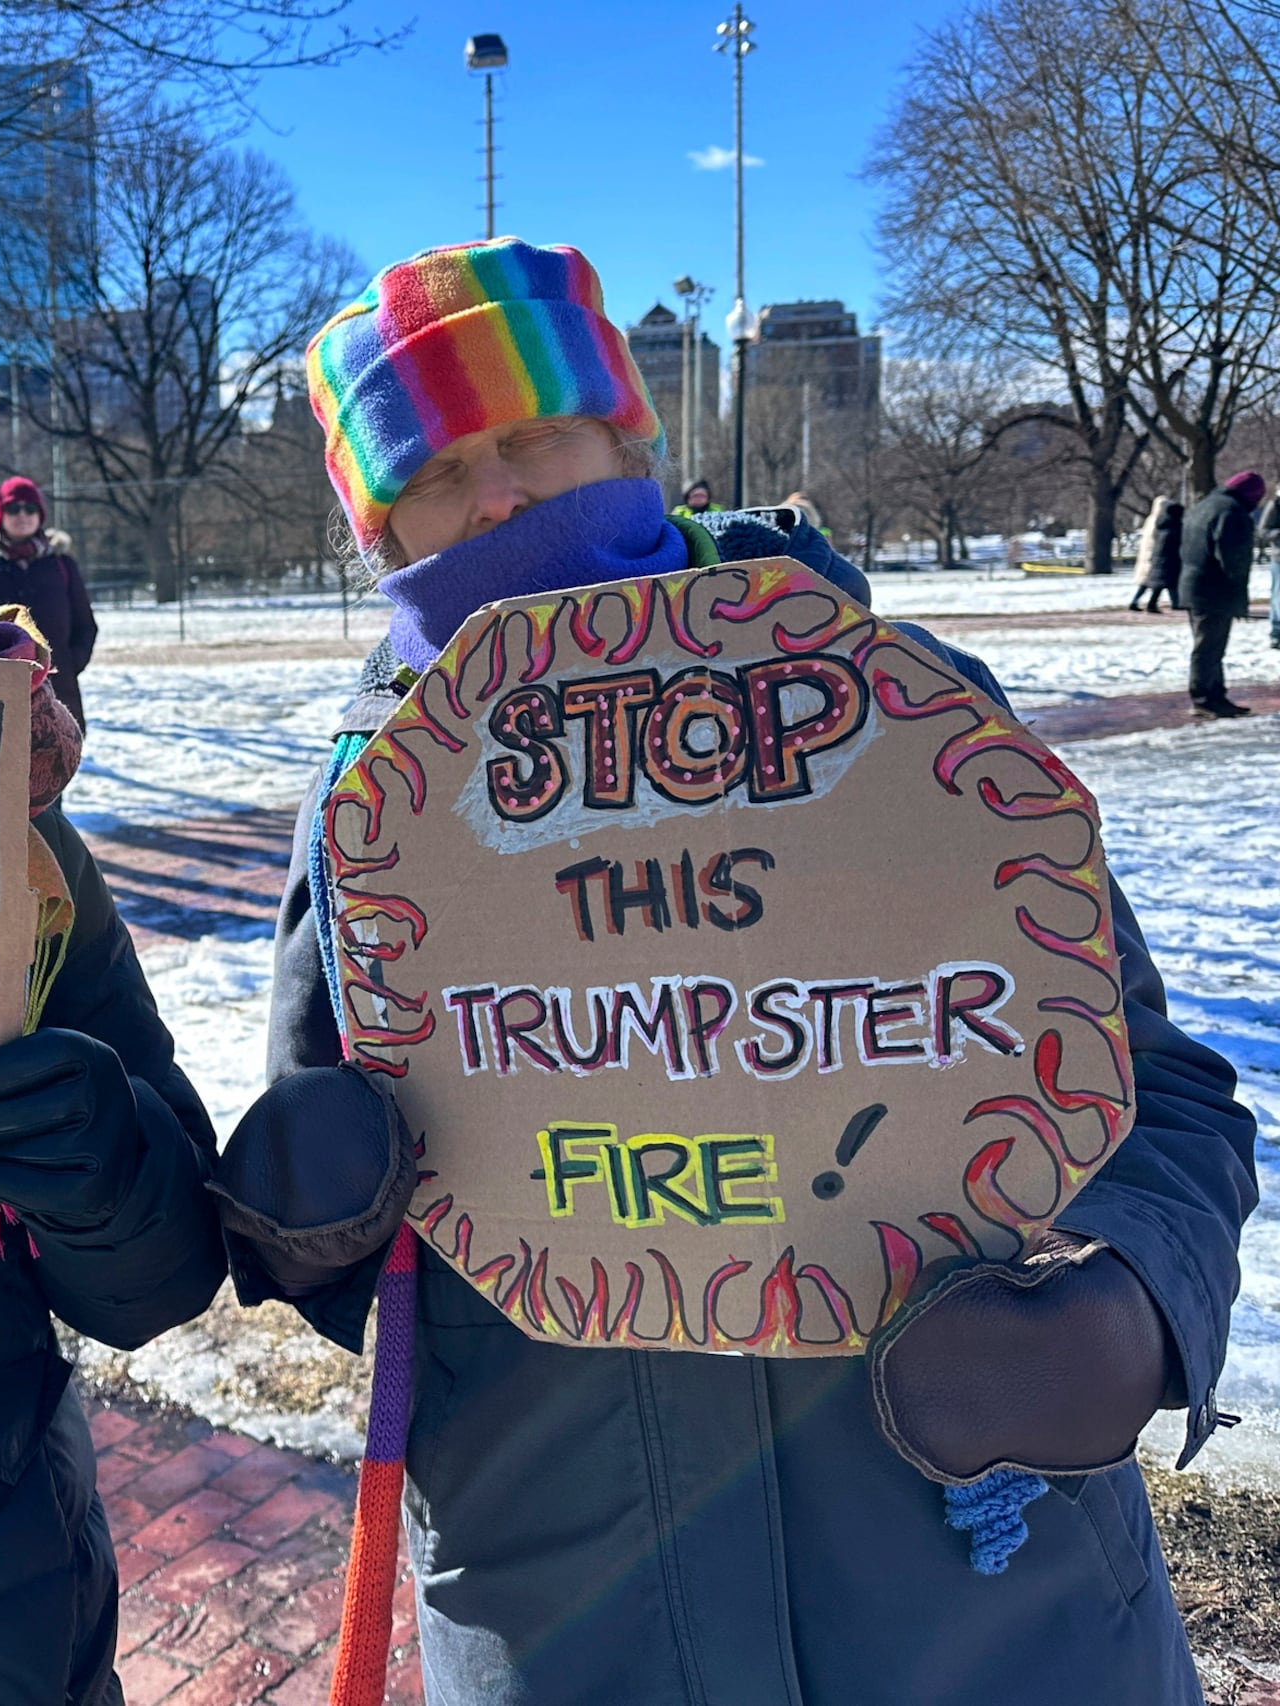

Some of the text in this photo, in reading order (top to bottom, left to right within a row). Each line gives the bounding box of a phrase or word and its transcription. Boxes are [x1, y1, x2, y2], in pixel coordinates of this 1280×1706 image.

[488, 652, 869, 822] STOP
[555, 847, 775, 942] THIS
[442, 960, 1025, 1081] TRUMPSTER
